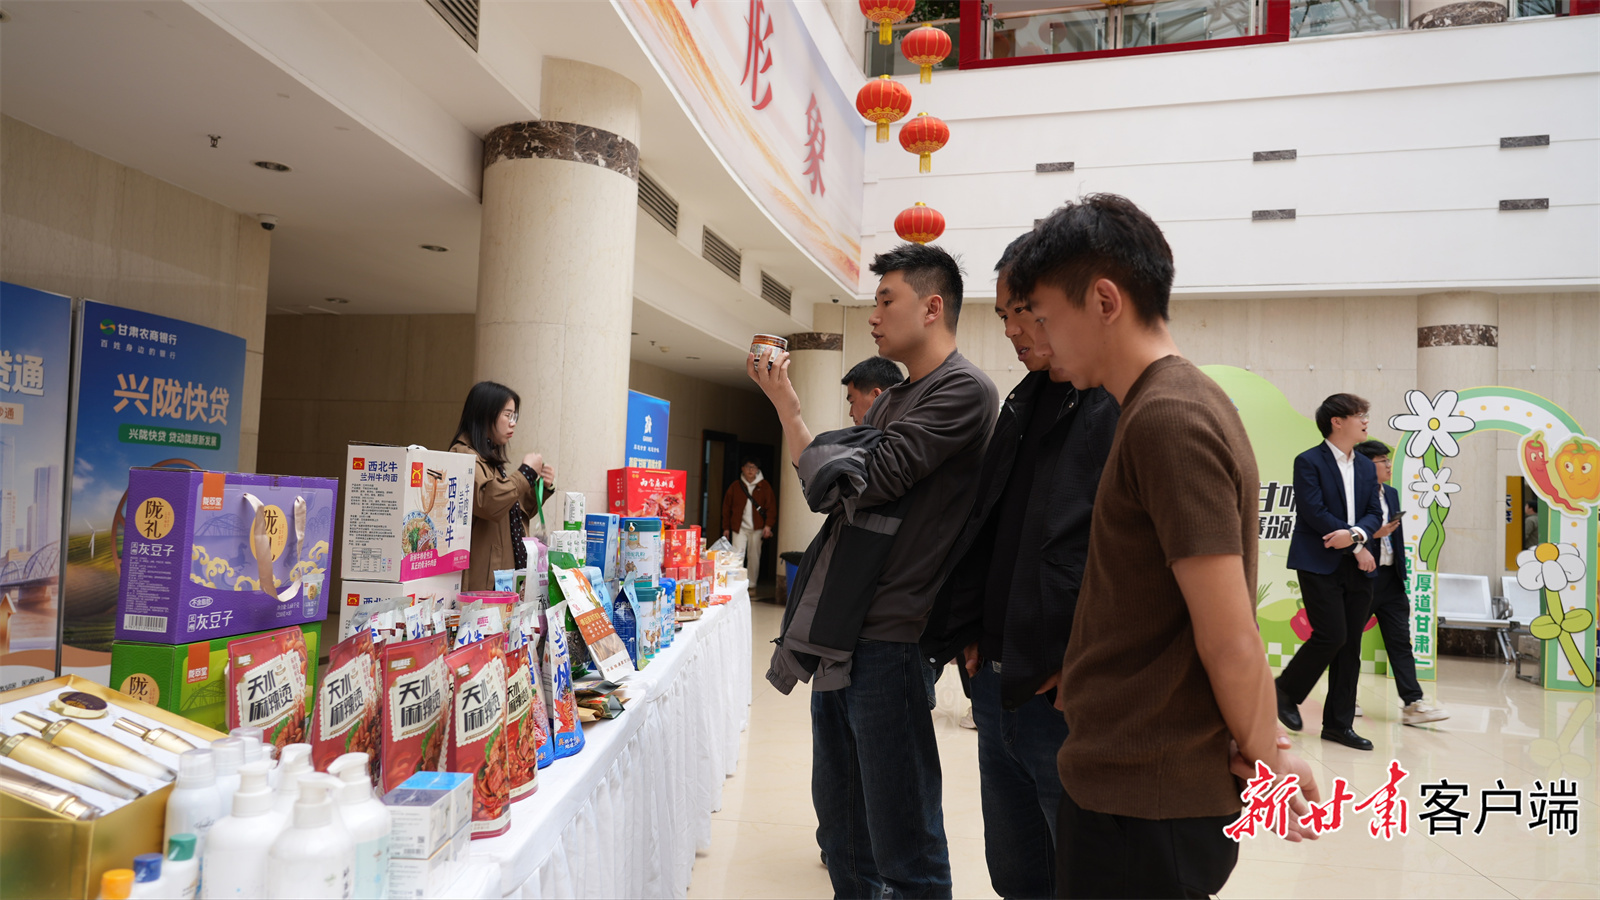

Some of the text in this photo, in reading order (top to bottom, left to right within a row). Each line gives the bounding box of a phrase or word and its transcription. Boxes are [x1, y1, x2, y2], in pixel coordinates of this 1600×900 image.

[117, 323, 177, 346] 甘肃农商银行
[0, 407, 14, 420] 通
[113, 373, 229, 426] 兴陇快贷
[128, 428, 167, 443] 兴陇快贷
[360, 472, 398, 483] 兰州牛肉面
[368, 461, 398, 472] 西北牛
[144, 500, 164, 539] 陇礼
[445, 476, 457, 548] 西北牛
[138, 542, 175, 557] 灰豆子
[196, 610, 234, 631] 灰豆子
[248, 669, 276, 701] 天水
[327, 673, 352, 706] 天水
[399, 674, 431, 705] 天水
[462, 679, 489, 711] 天水
[249, 682, 294, 723] 麻辣烫
[330, 686, 364, 728] 麻辣烫
[401, 688, 441, 728] 麻辣烫
[464, 690, 501, 733] 麻辣烫
